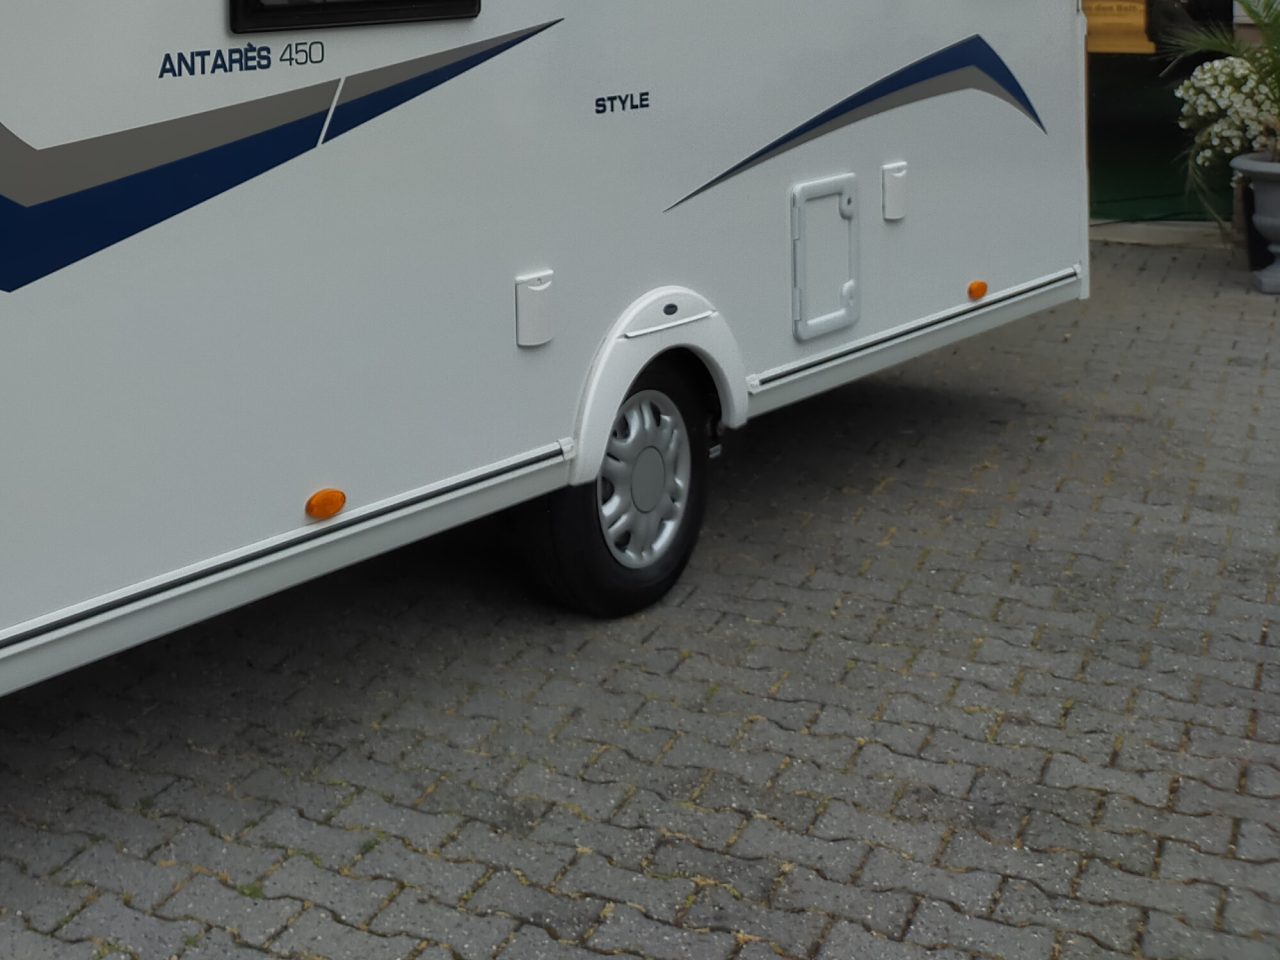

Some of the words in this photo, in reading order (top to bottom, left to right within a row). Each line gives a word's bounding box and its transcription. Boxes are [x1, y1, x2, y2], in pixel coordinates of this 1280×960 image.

[158, 42, 271, 78] ANTARÈS
[279, 41, 324, 66] 450
[595, 91, 649, 114] STYLE
